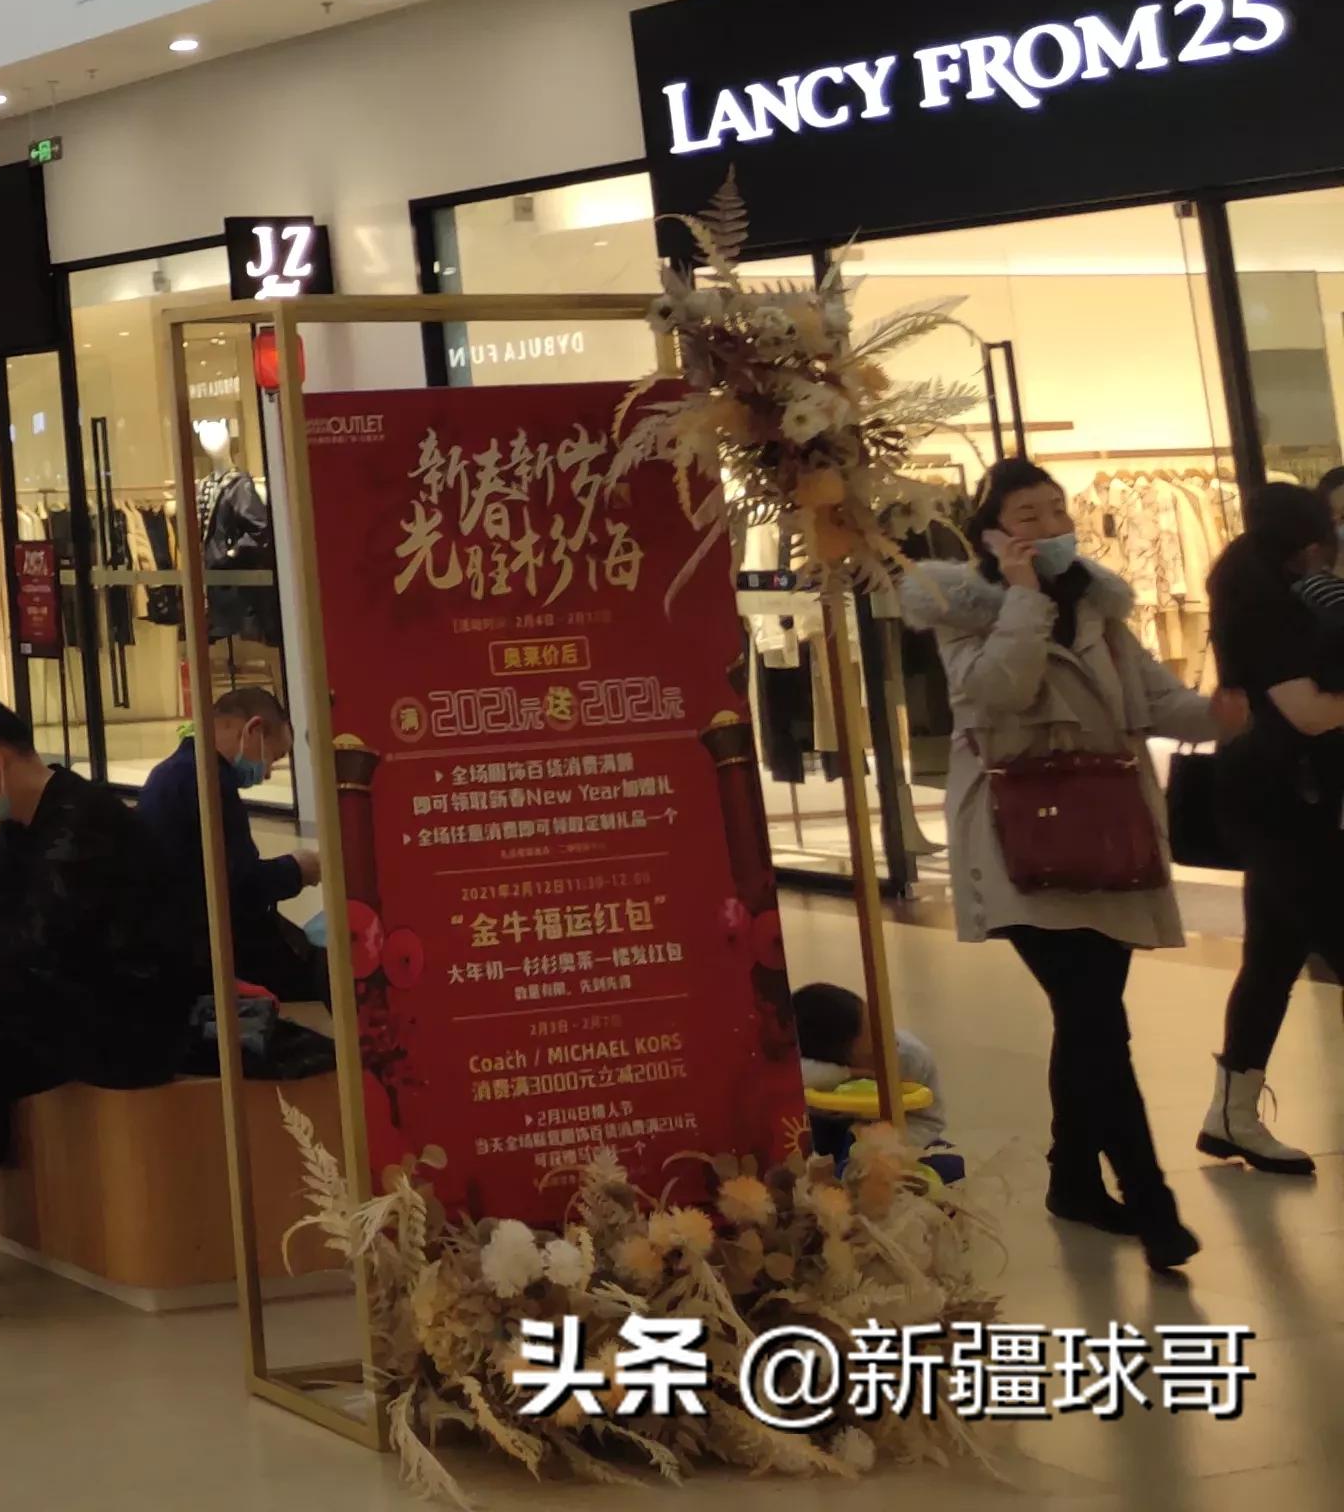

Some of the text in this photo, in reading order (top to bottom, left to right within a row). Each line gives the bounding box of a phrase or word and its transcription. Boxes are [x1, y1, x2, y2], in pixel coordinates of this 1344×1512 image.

[662, 54, 899, 155] LANCY
[912, 4, 1170, 110] FROM
[246, 225, 312, 277] JZ
[328, 414, 384, 434] OUTLET
[408, 423, 607, 552] 新春新岁
[468, 1049, 528, 1074] Coach
[547, 1039, 630, 1065] MICHAEL
[634, 1032, 684, 1055] KORS
